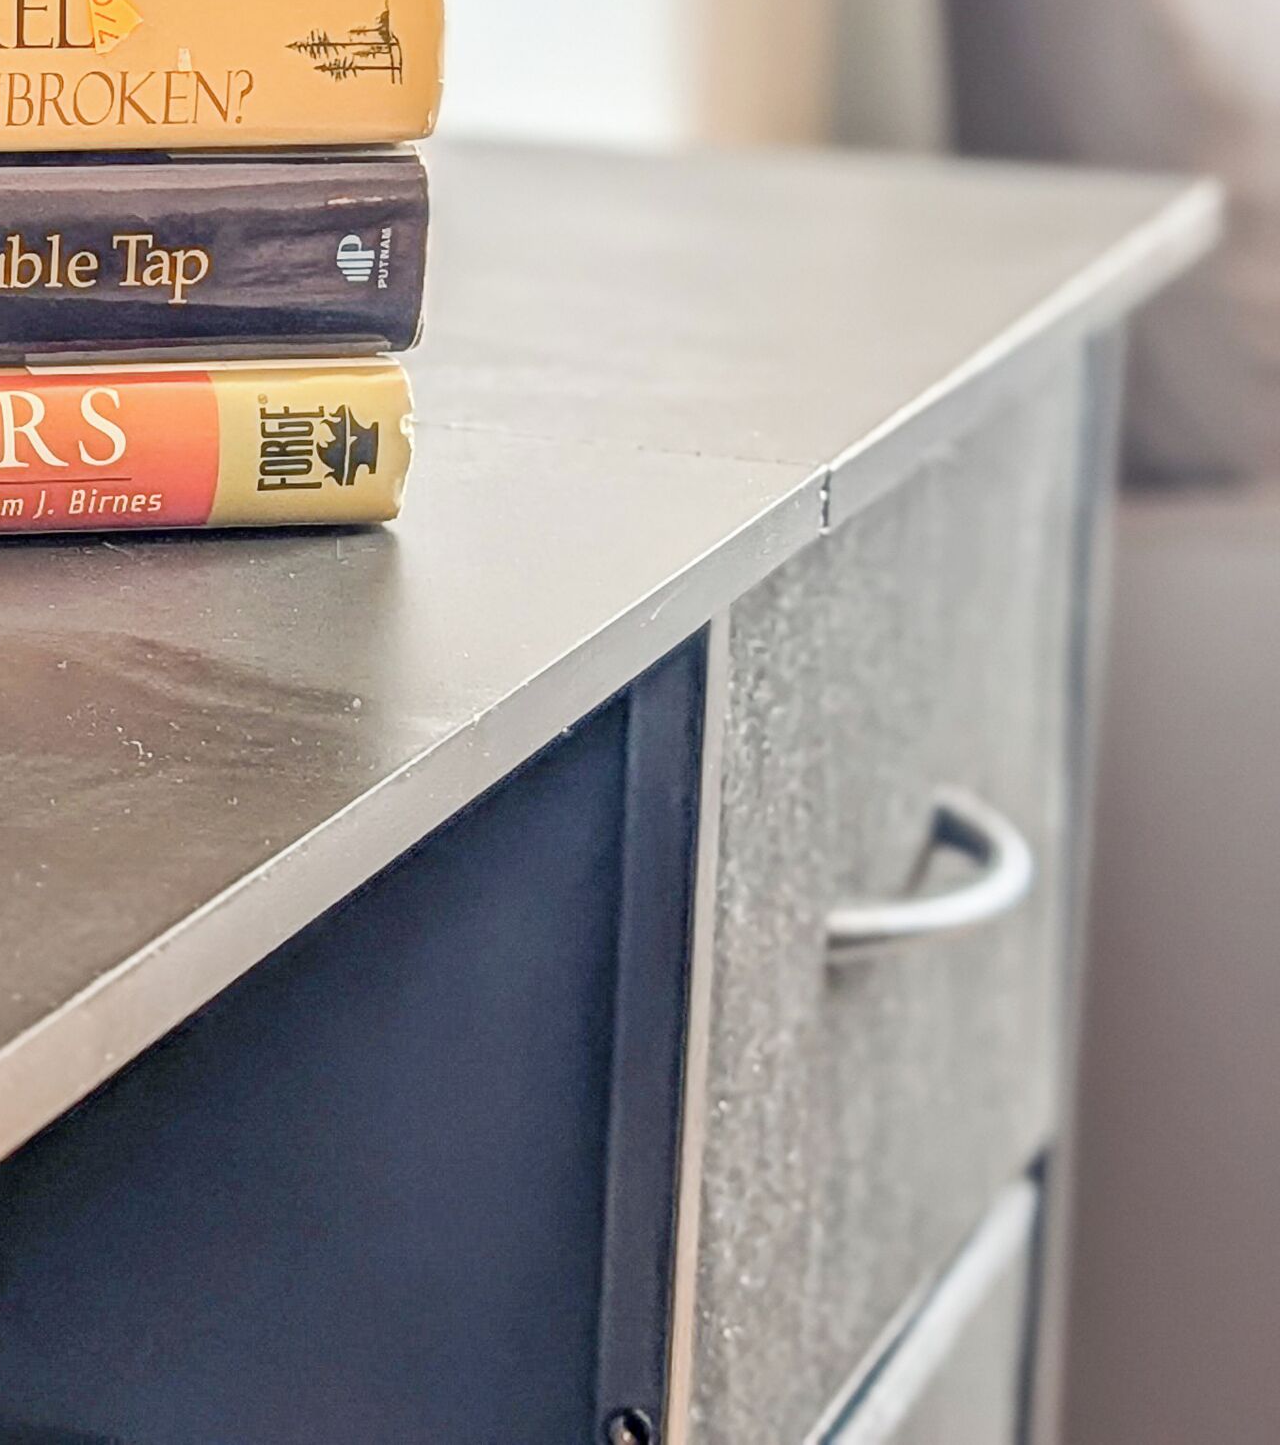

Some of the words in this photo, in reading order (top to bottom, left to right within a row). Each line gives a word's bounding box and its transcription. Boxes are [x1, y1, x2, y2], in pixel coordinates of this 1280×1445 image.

[113, 234, 209, 304] Tap
[378, 227, 392, 289] PUTNAM
[257, 406, 324, 491] FORGE
[33, 491, 54, 519] J.
[68, 488, 163, 515] Birnes
